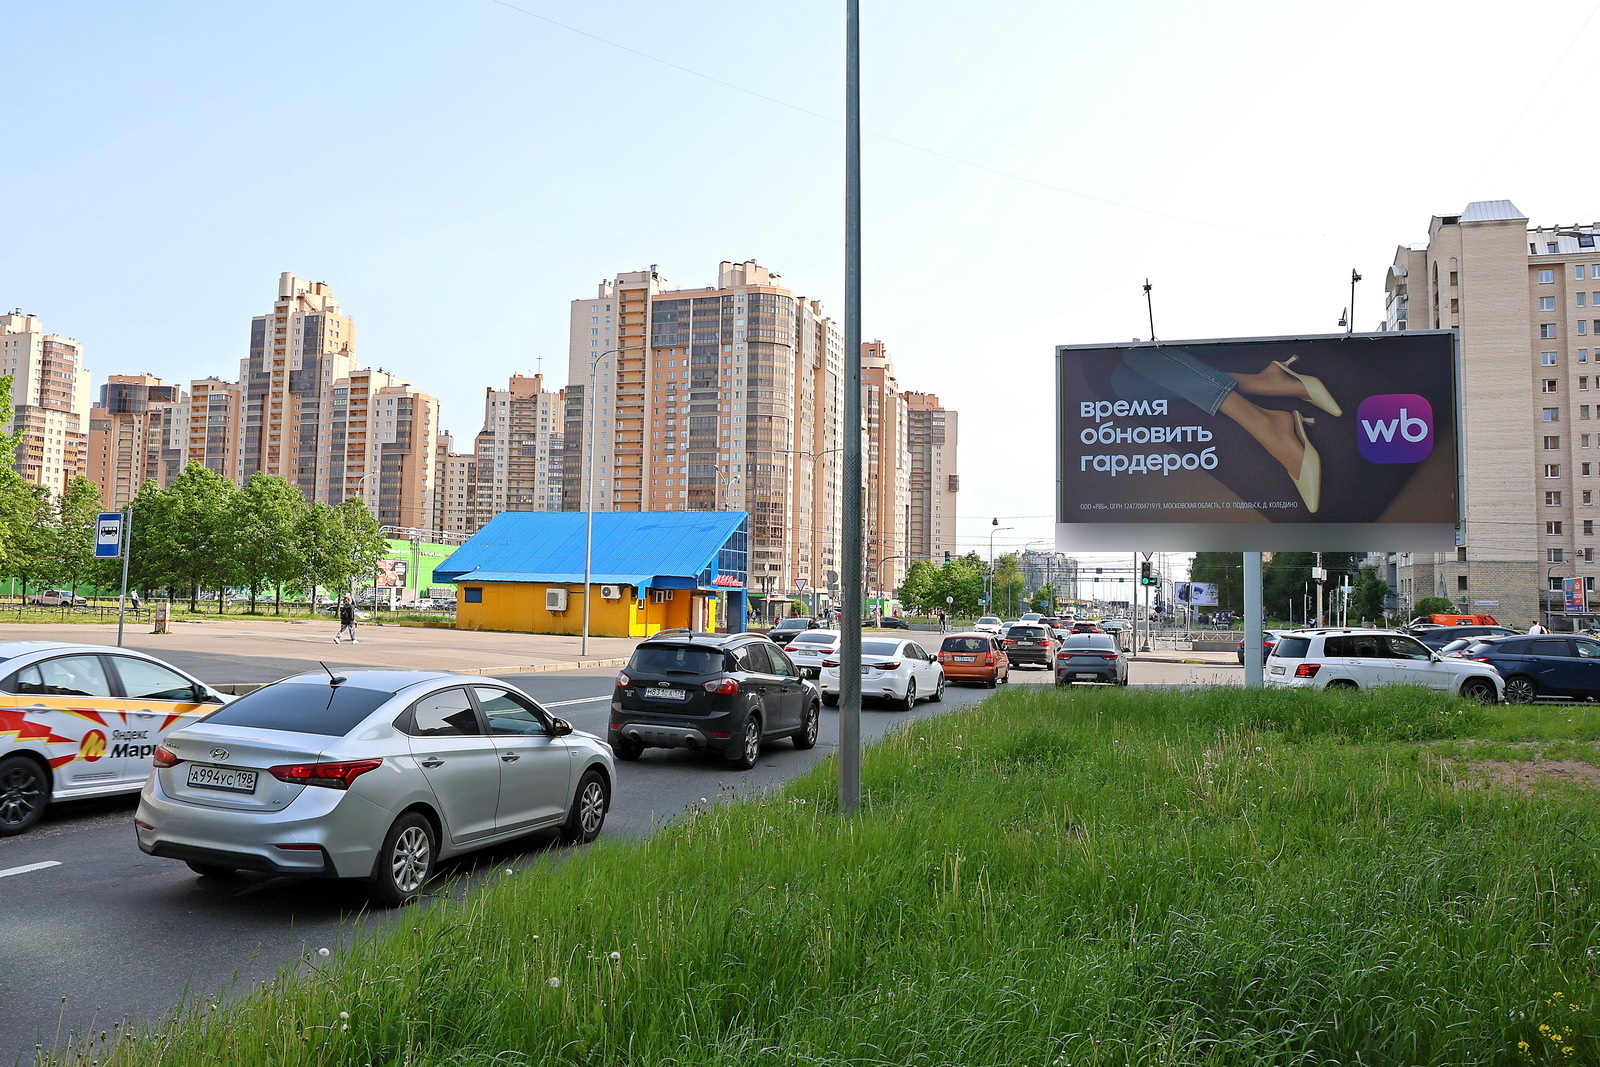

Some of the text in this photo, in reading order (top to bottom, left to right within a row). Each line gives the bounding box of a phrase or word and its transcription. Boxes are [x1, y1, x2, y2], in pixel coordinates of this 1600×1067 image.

[1080, 399, 1168, 423] время
[1080, 421, 1213, 445] обновить
[1361, 408, 1429, 443] wb
[1080, 446, 1219, 477] гардероб
[1232, 501, 1261, 509] ПОДОЛЬСК,
[1269, 501, 1298, 509] КОЛЕДИНО
[112, 729, 149, 741] Яндекс
[192, 768, 254, 786] А994УС 198
